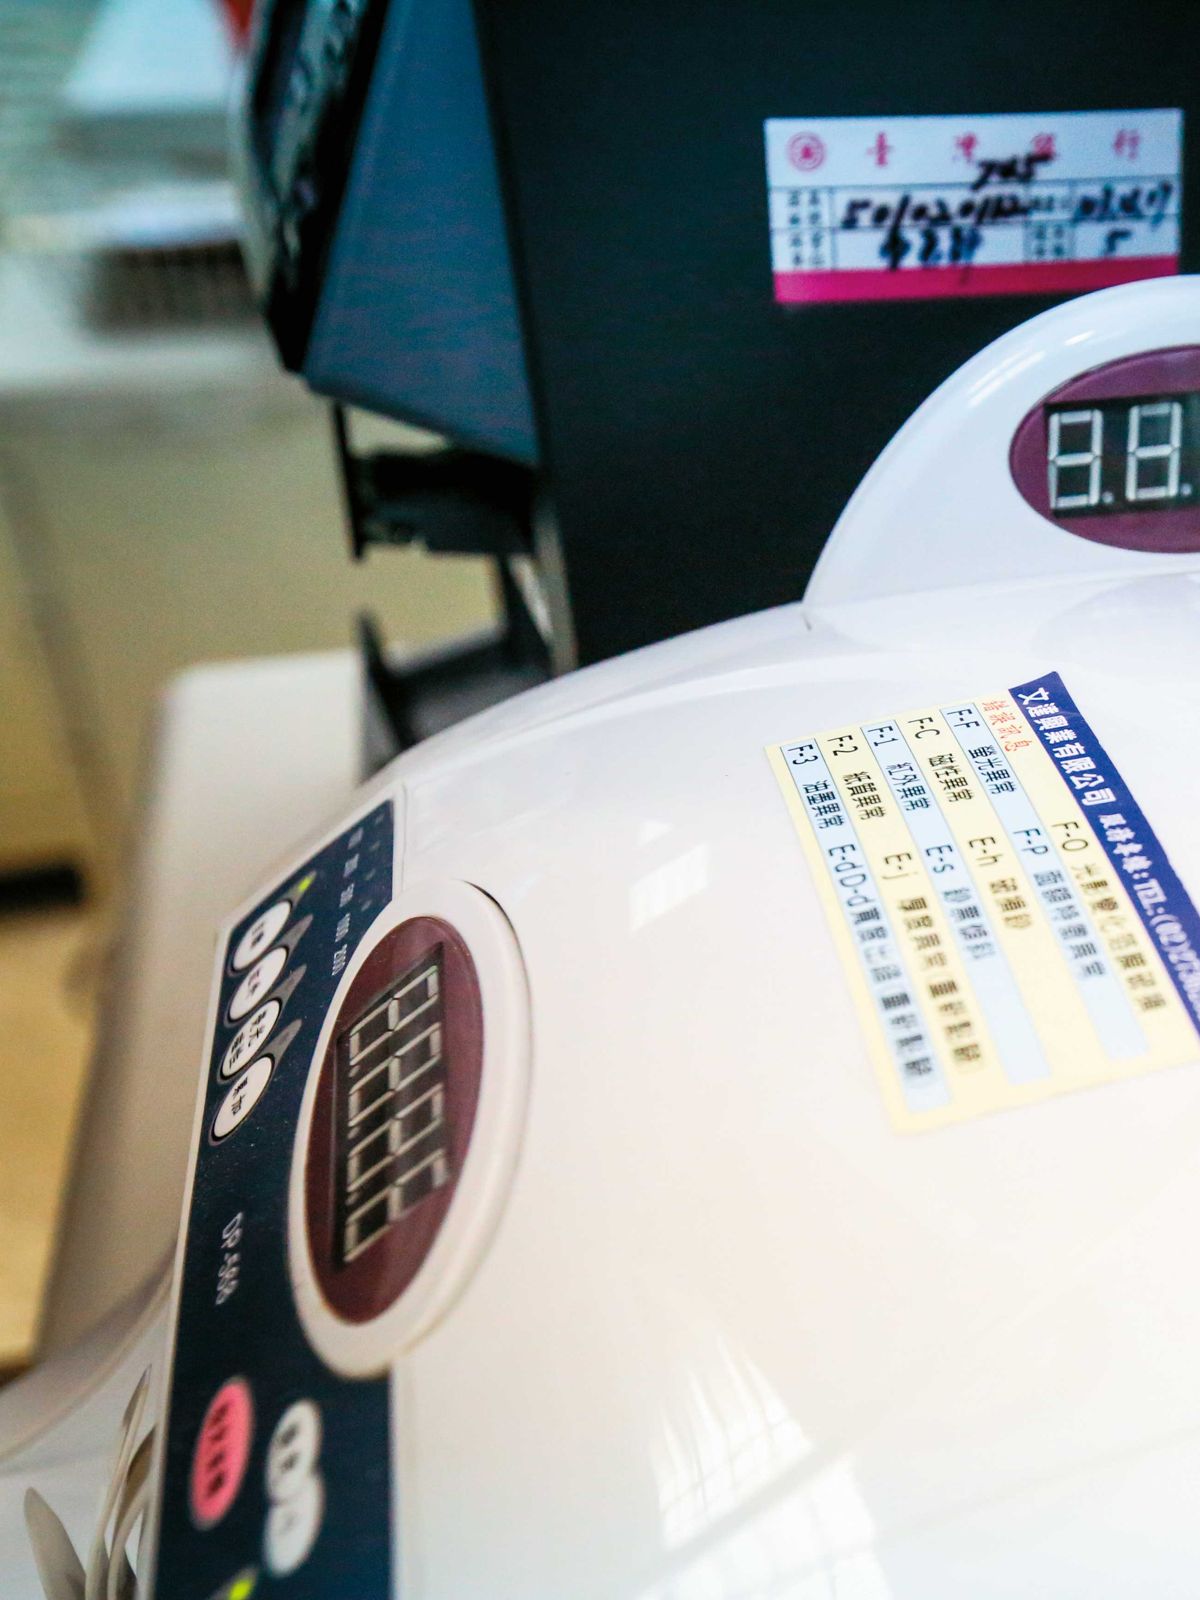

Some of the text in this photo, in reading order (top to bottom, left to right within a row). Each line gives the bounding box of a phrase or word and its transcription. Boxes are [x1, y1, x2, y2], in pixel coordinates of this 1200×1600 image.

[787, 743, 818, 765] F-3
[826, 734, 858, 756] F-2
[842, 770, 886, 820] 紙質異常
[867, 725, 899, 747] F-1
[885, 761, 932, 812] 紅外異常
[907, 716, 940, 739] F-C
[927, 752, 975, 803] 磁性異常
[946, 707, 982, 730] F-F
[967, 744, 1016, 794] 螢光異常
[1012, 827, 1048, 855] F-P
